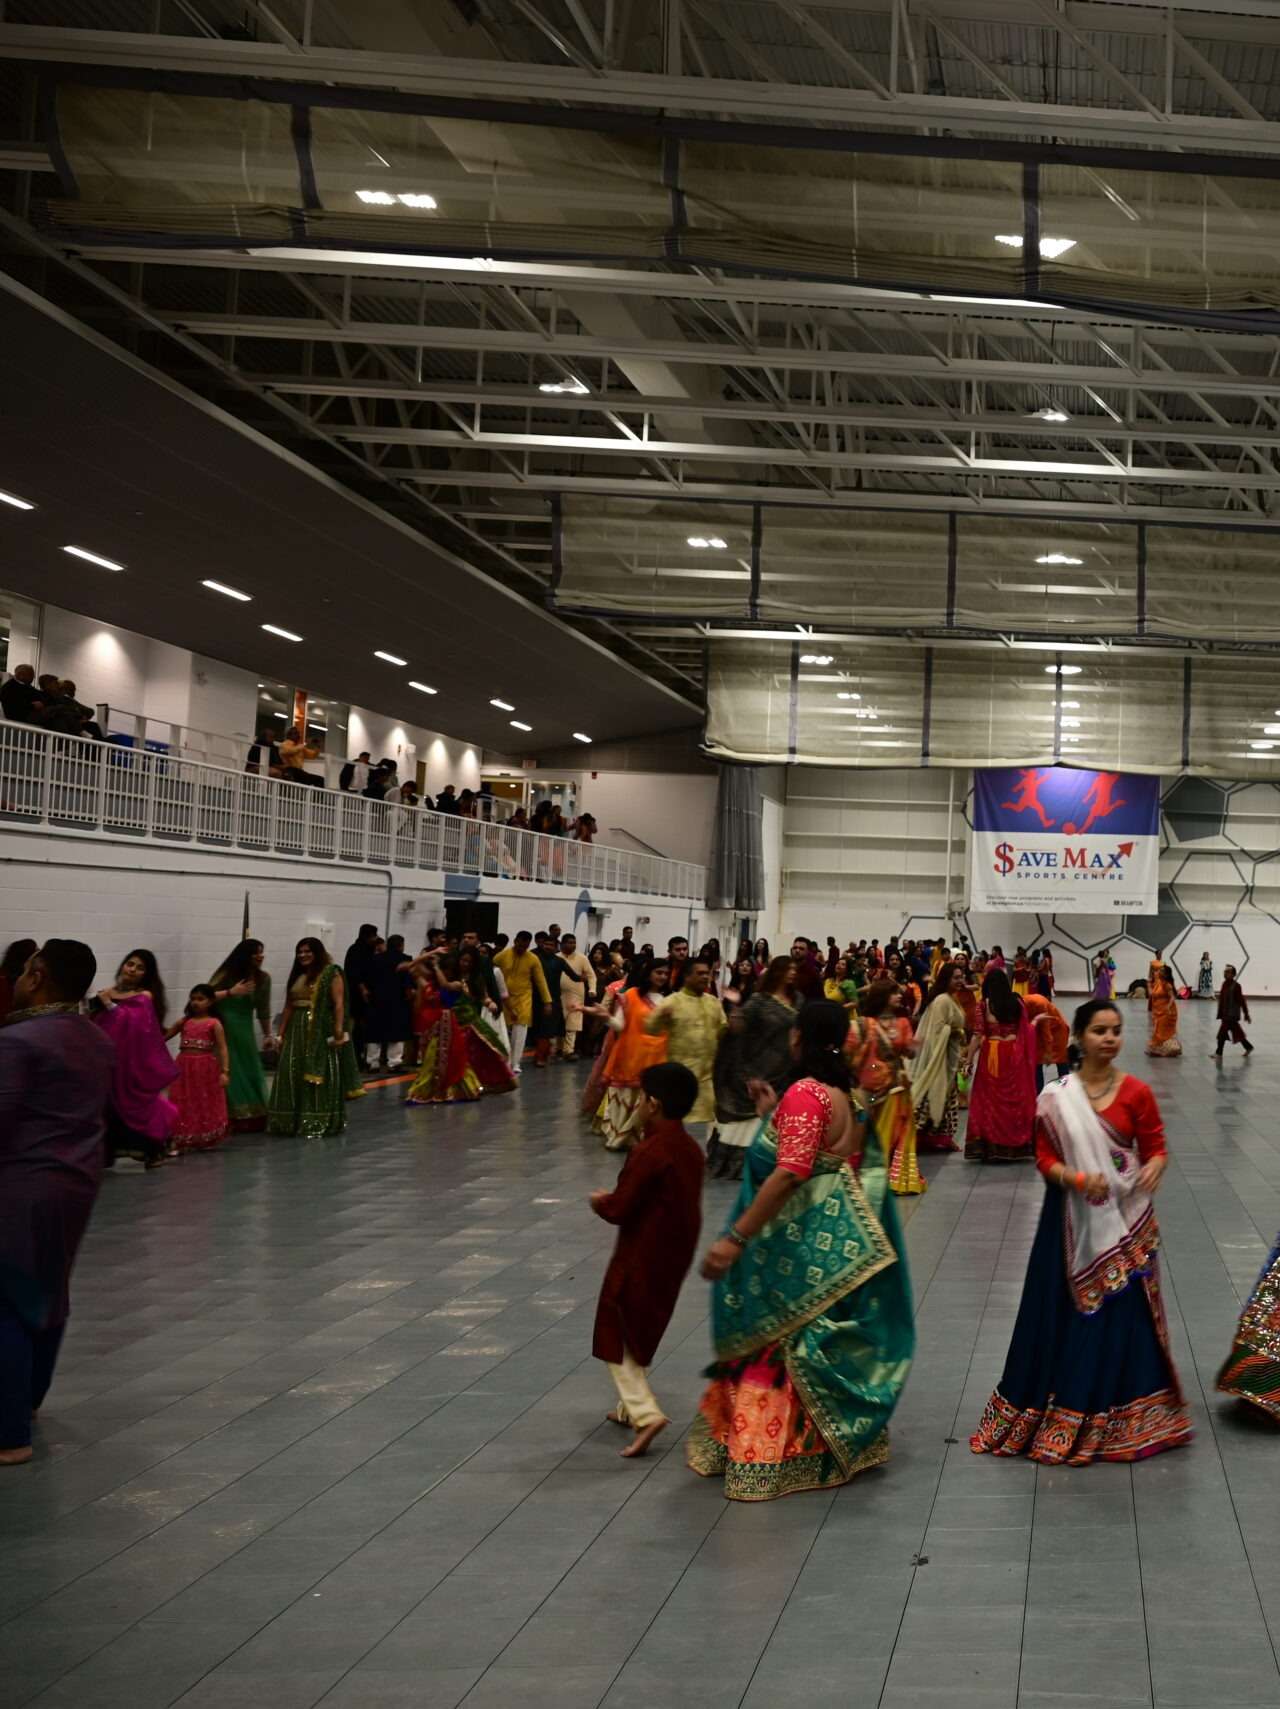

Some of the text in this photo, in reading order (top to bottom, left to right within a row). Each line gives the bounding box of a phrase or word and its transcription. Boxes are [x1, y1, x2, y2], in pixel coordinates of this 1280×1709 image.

[1062, 846, 1124, 869] MAX
[1016, 872, 1123, 881] SPORTS CENTRE
